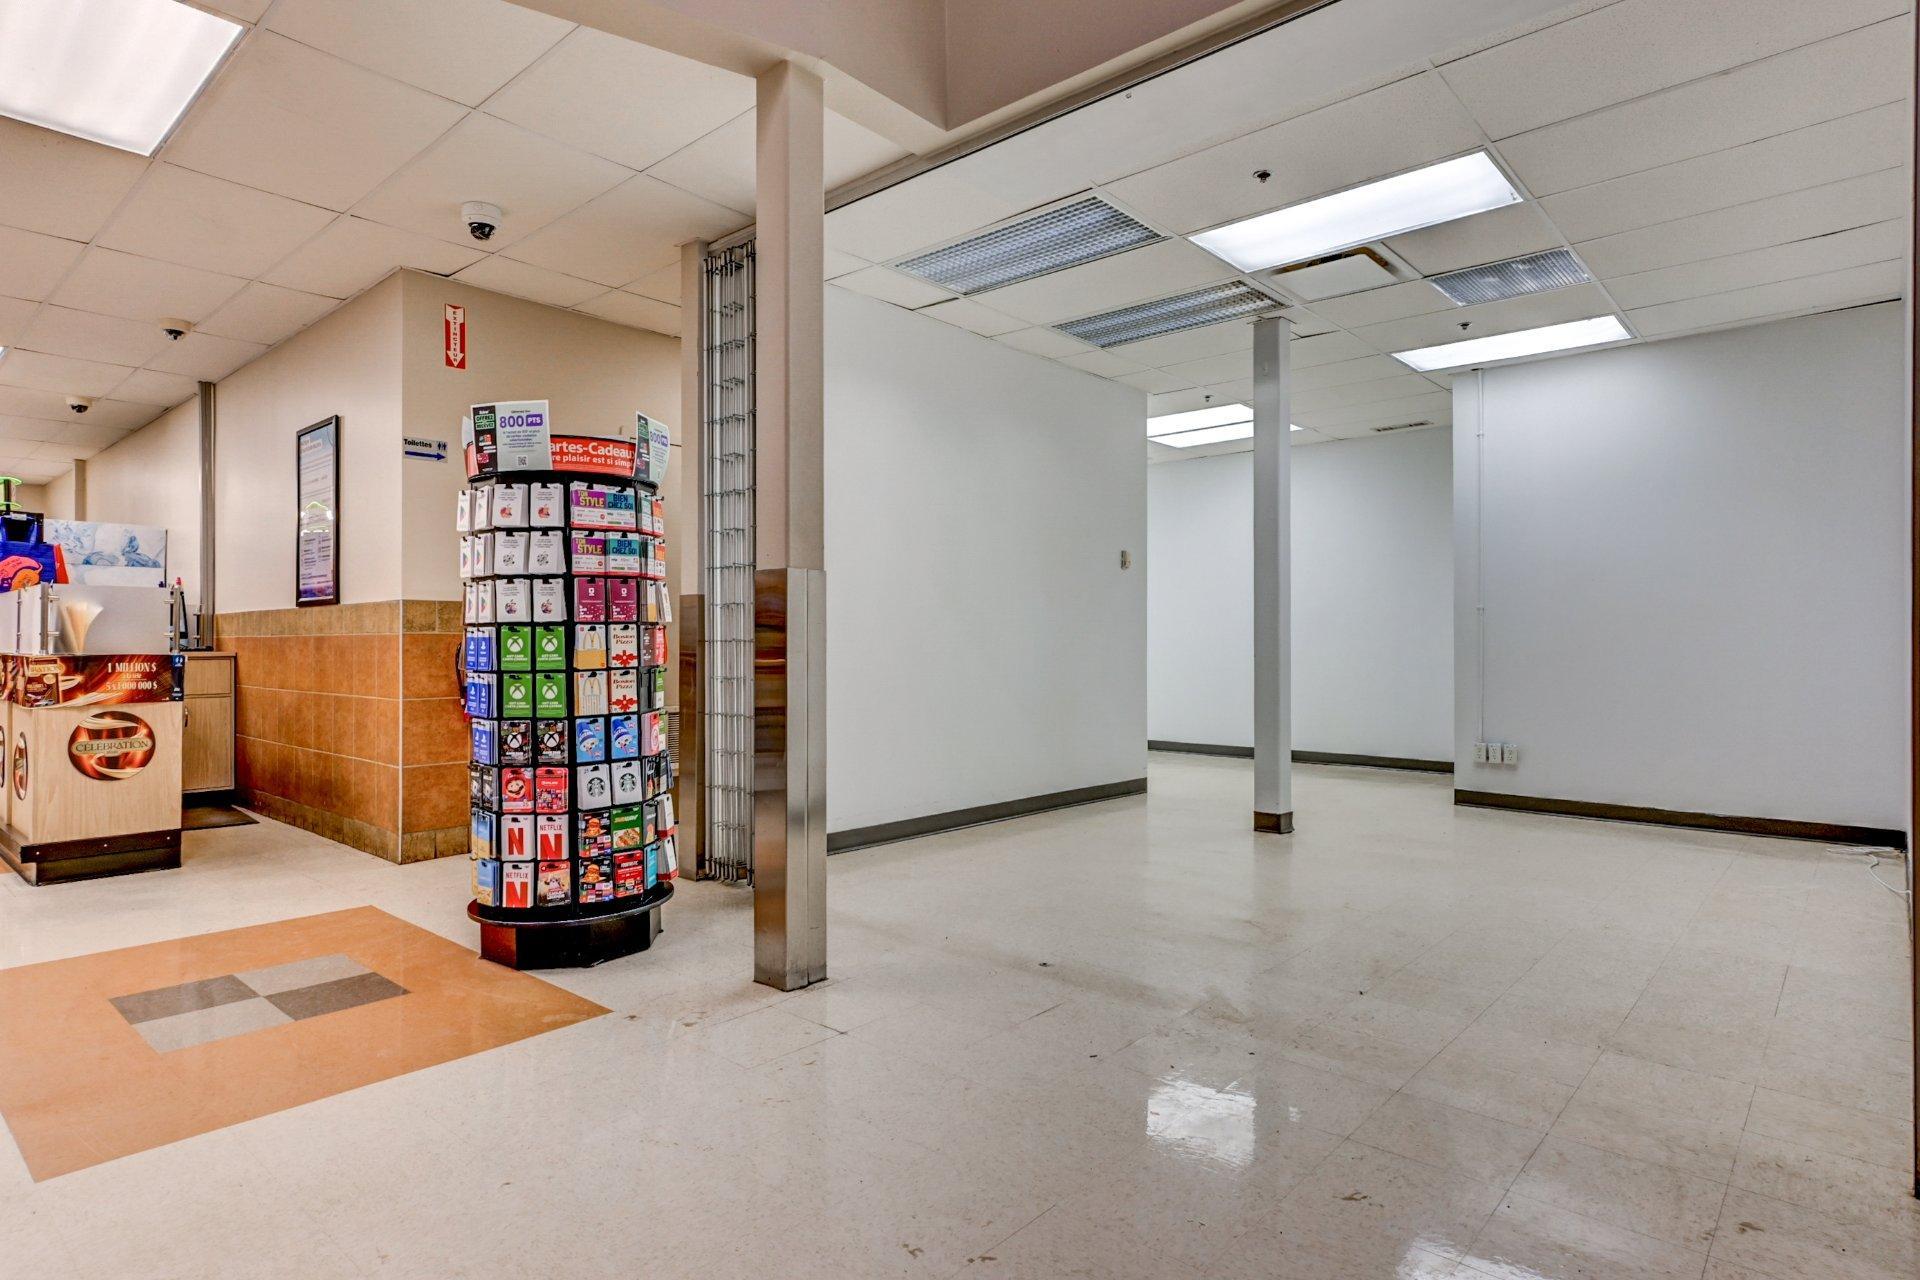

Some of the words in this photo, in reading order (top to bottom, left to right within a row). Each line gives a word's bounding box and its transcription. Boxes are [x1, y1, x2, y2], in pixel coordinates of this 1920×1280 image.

[500, 416, 524, 428] 800
[404, 438, 432, 448] Toilettes
[550, 442, 634, 458] artes-Cadeaux
[563, 454, 590, 463] plaisir
[580, 497, 604, 507] STYLE
[613, 494, 628, 502] BIEN
[578, 545, 602, 554] STYLE
[108, 663, 112, 673] 1
[115, 663, 150, 672] MILLION
[151, 662, 156, 673] $
[138, 681, 152, 690] 000
[153, 681, 157, 690] $
[508, 828, 524, 855] N
[540, 834, 562, 860] N
[506, 882, 528, 907] N
